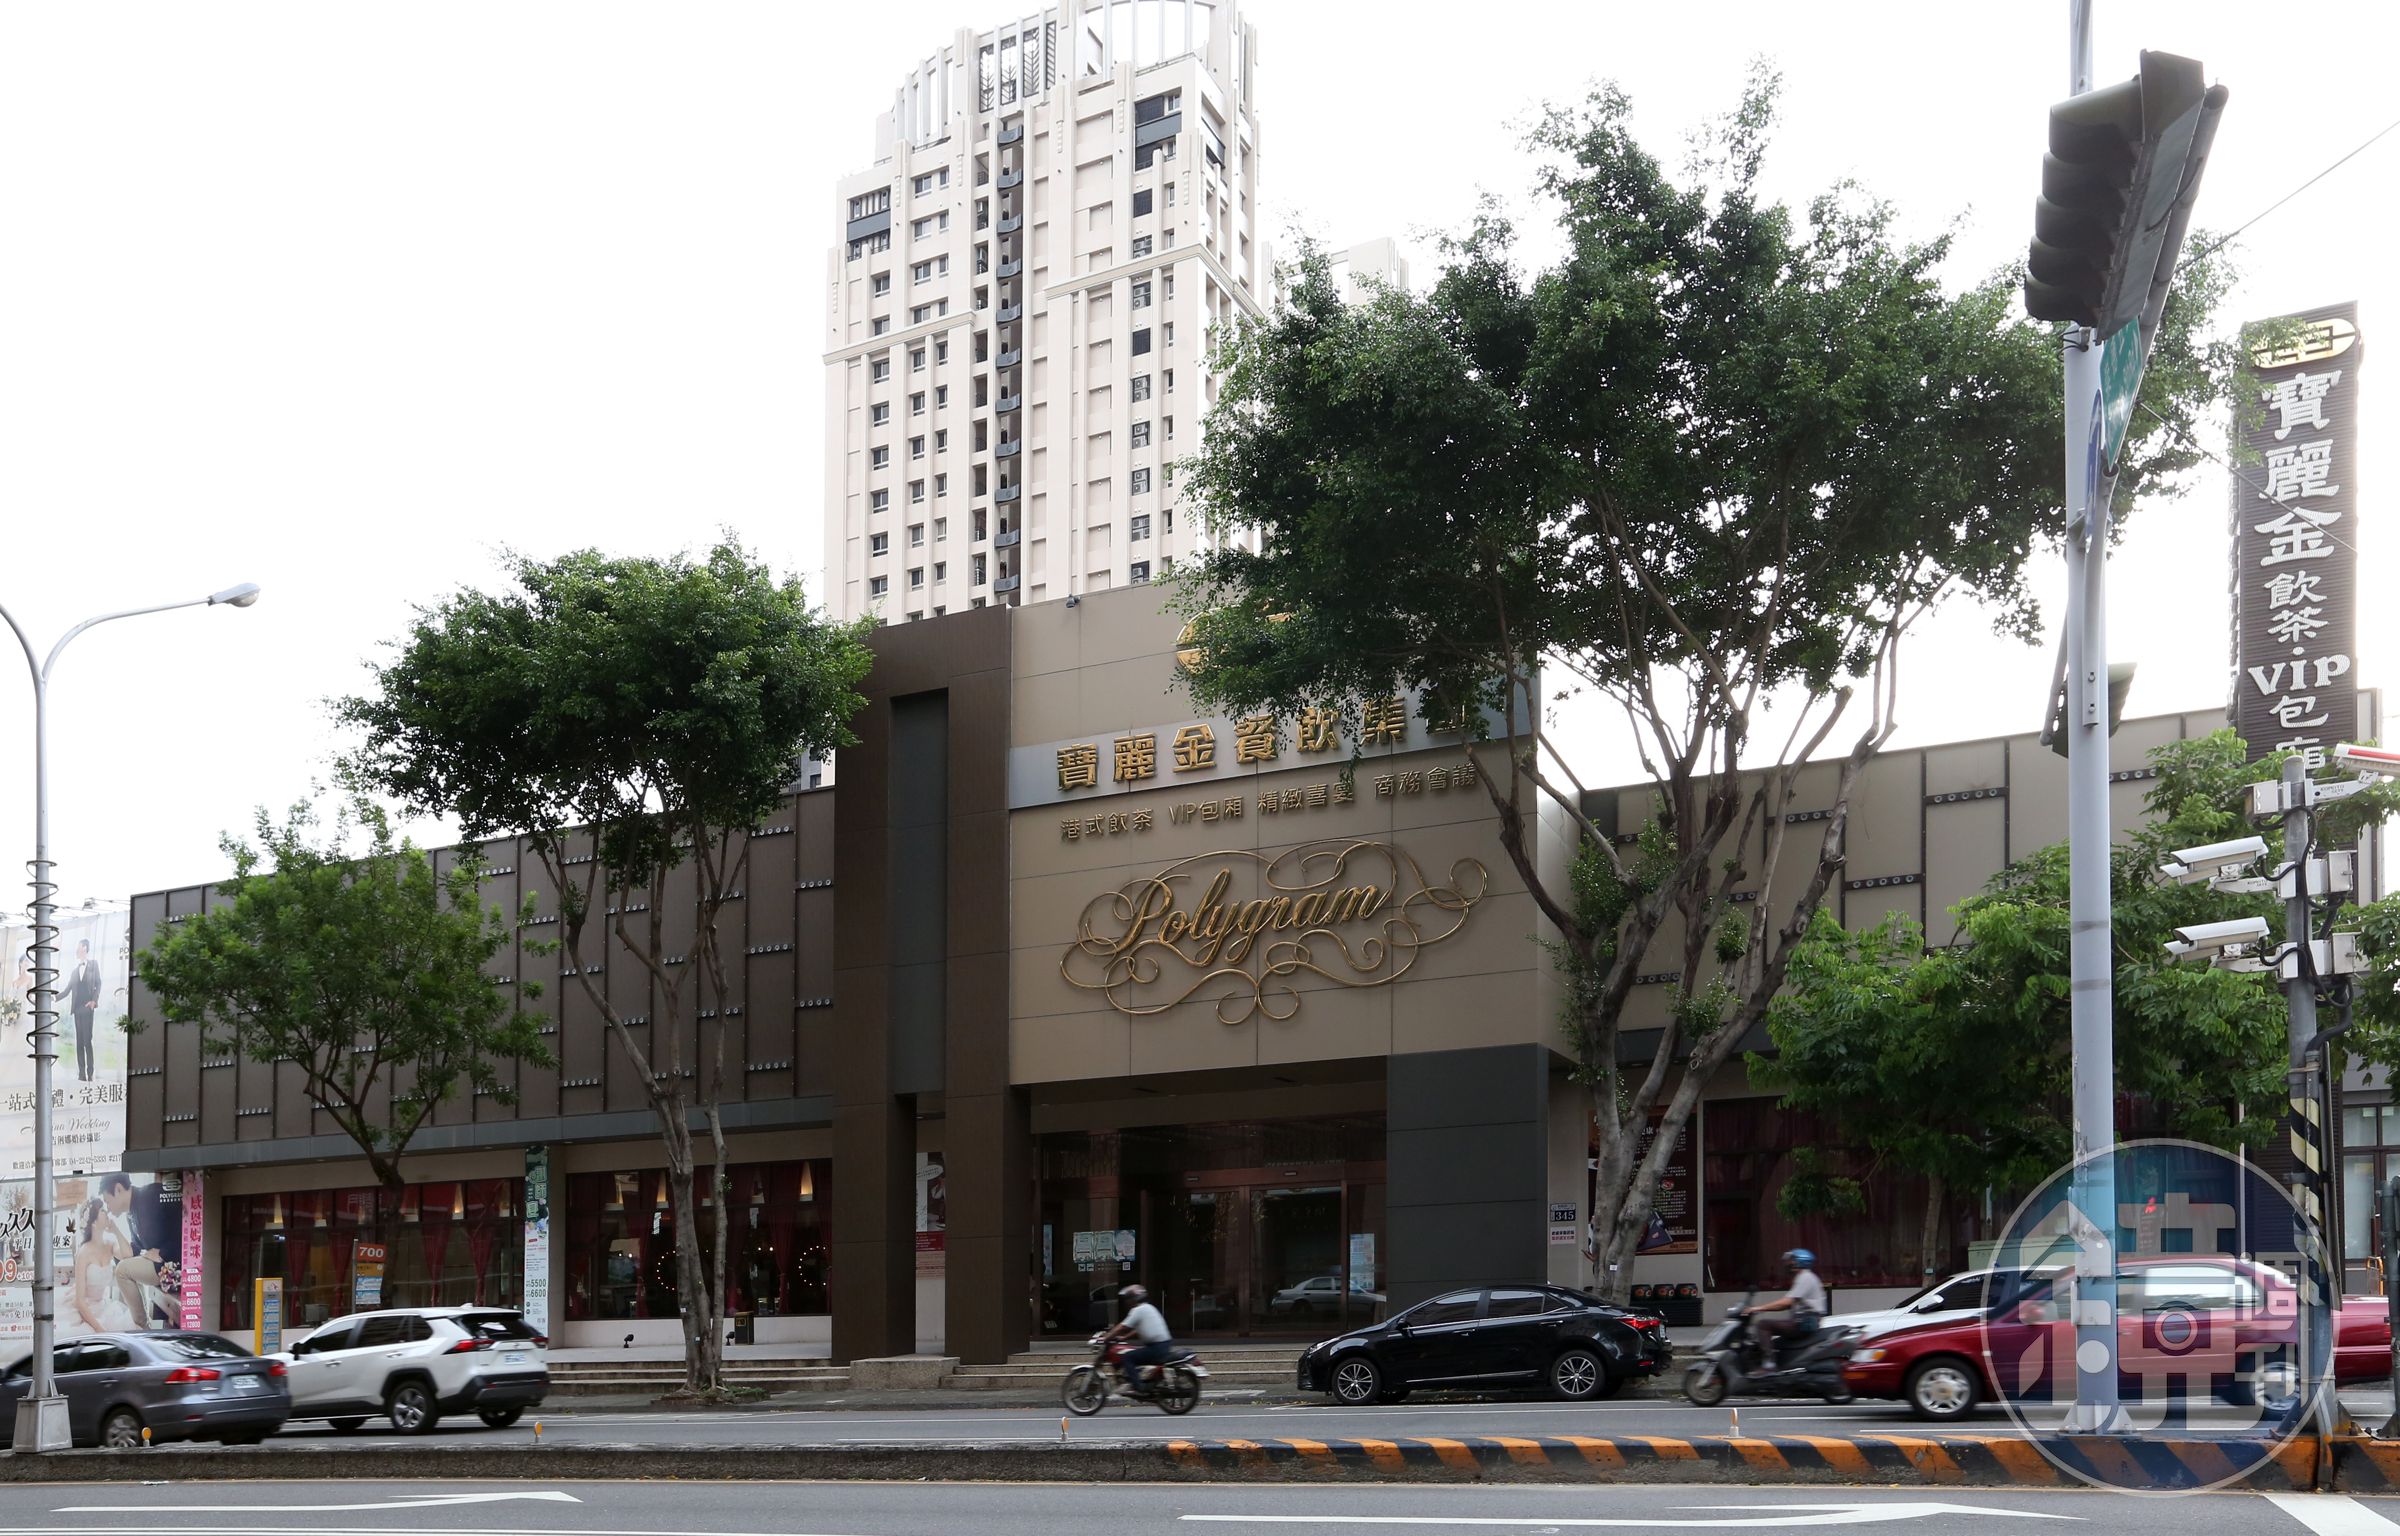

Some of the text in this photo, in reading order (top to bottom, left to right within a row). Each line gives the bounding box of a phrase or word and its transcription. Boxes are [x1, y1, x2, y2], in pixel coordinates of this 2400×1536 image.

[1057, 697, 1466, 791] 寶麗金餐飲集
[1060, 762, 1477, 841] 港式飲茶 VIP包廂 精緻喜宴 商務會議
[1076, 850, 1400, 976] Polygram
[1555, 1211, 1575, 1221] 345
[360, 1246, 384, 1258] 700
[531, 1278, 547, 1288] 5500
[531, 1288, 547, 1298] 6600
